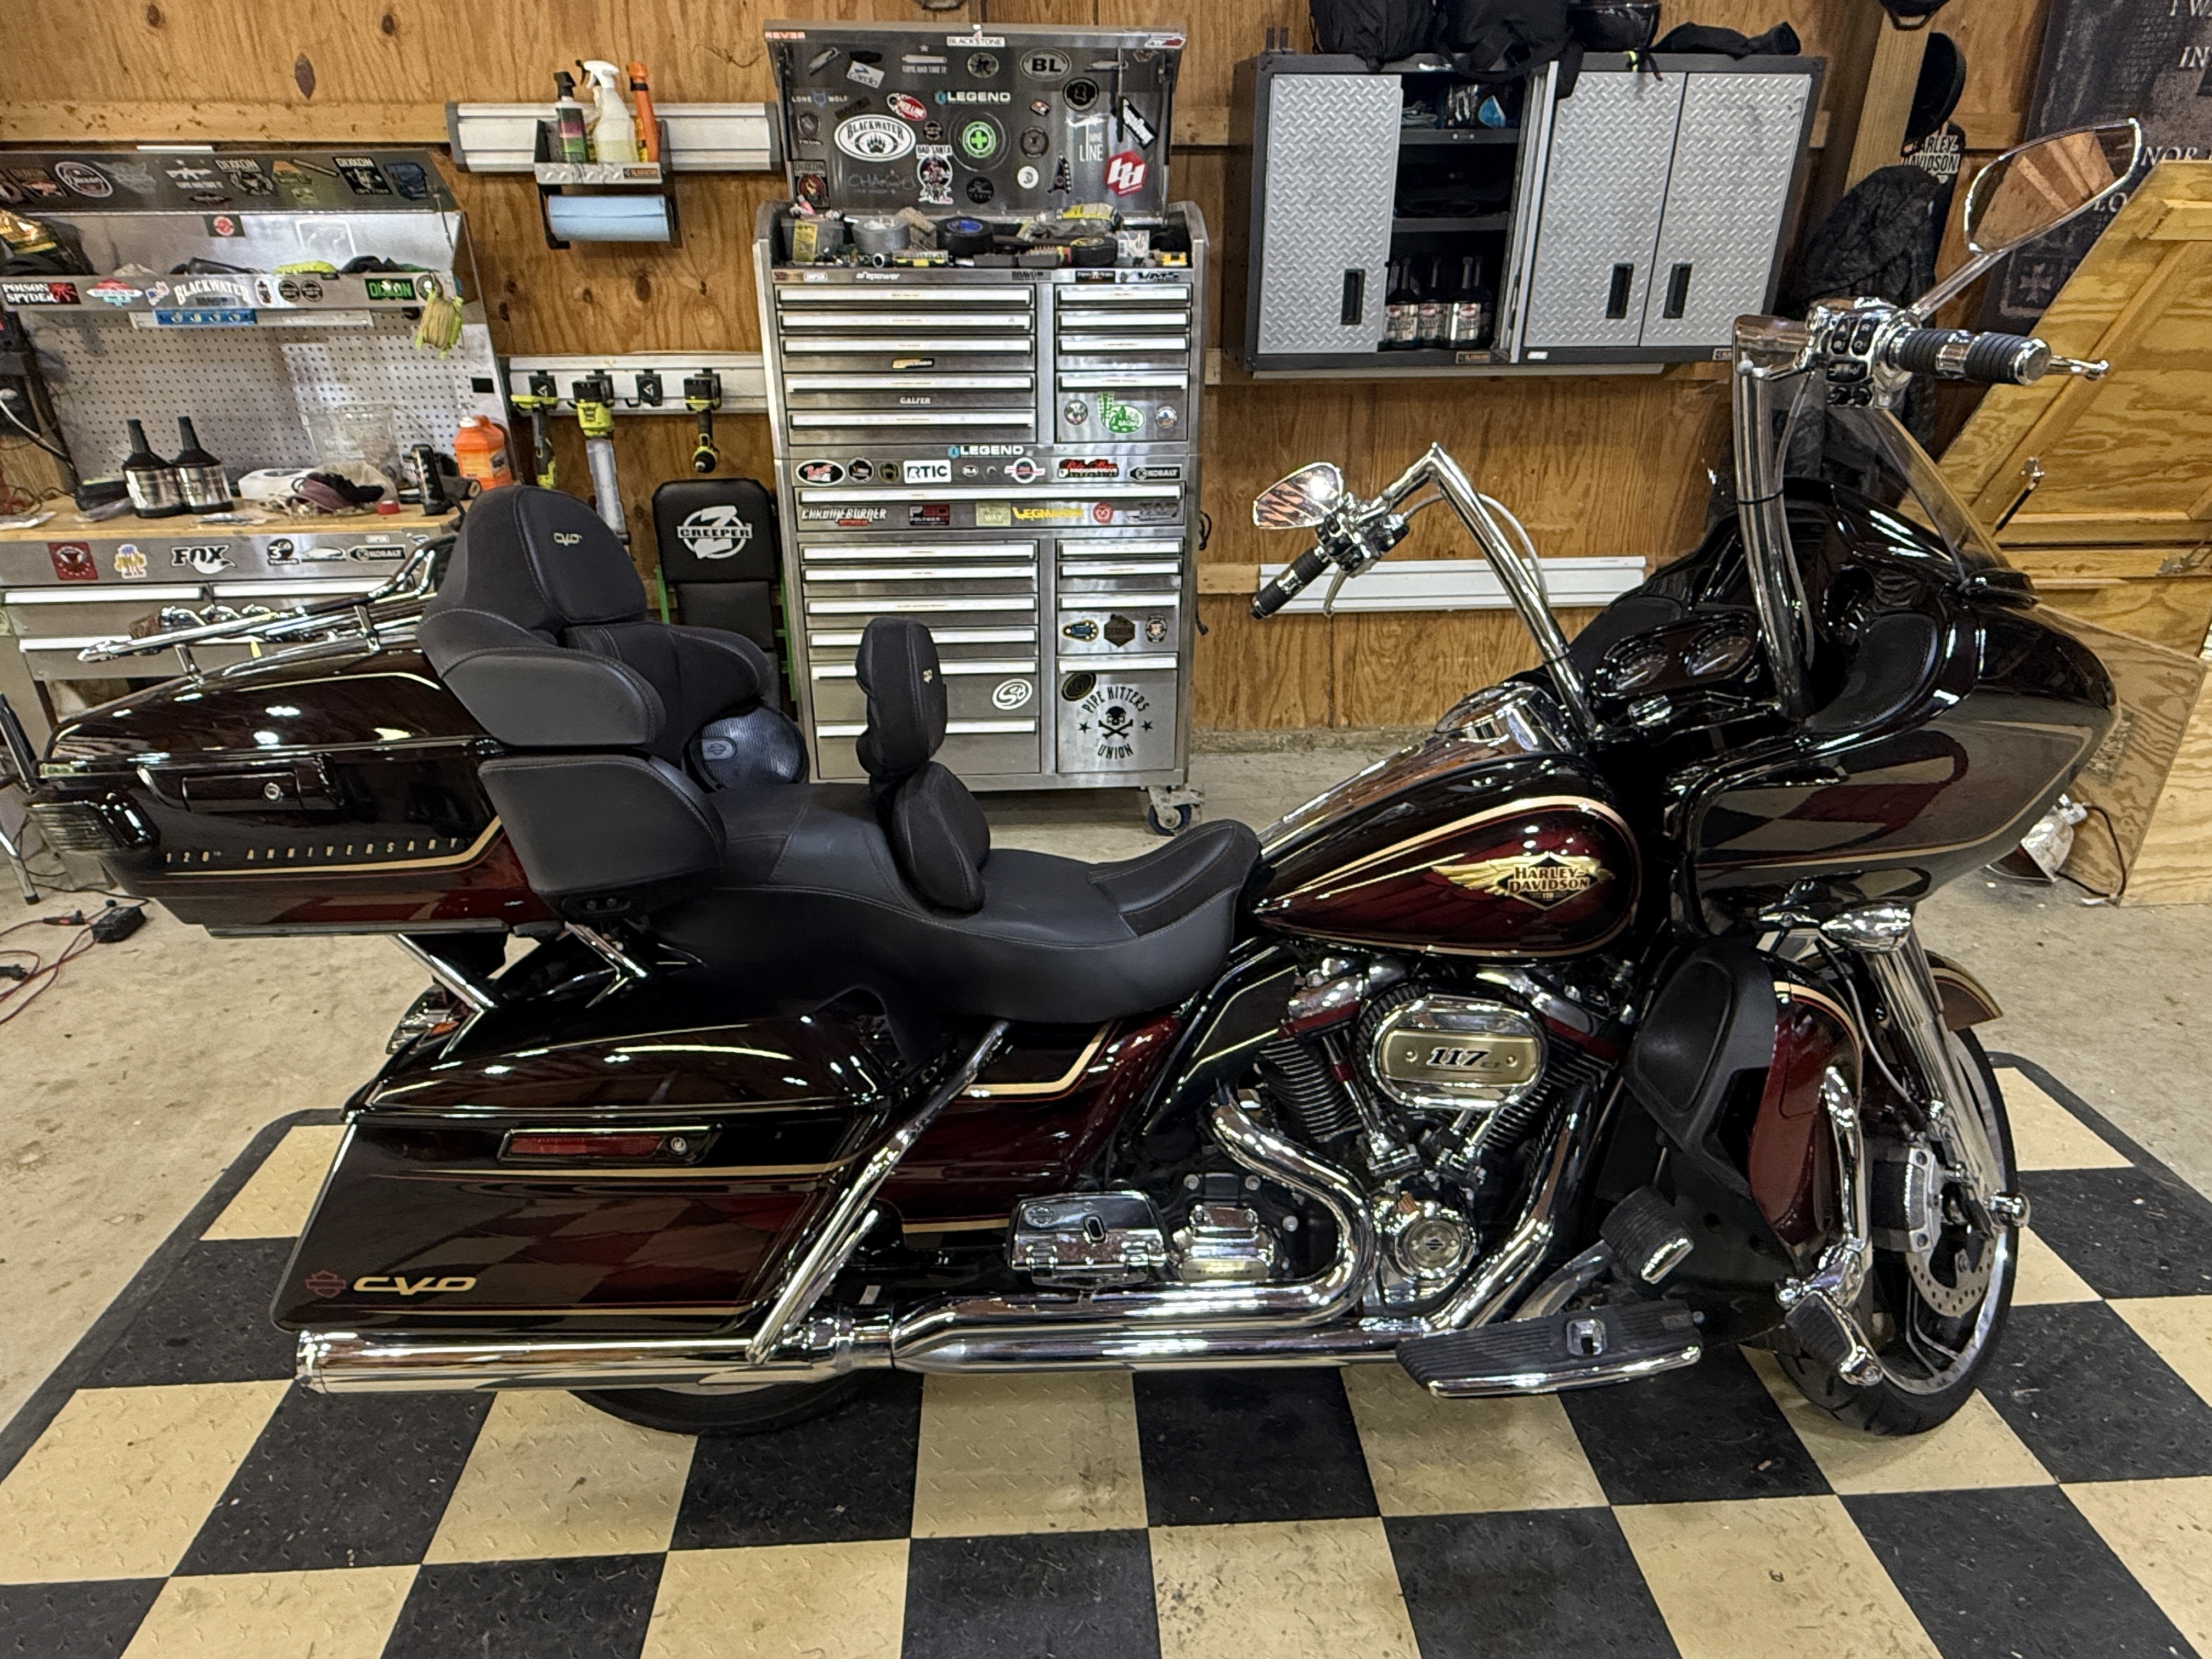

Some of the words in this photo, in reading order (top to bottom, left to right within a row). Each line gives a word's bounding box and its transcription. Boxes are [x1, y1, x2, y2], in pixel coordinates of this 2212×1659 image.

[2178, 46, 2212, 68] IN
[1031, 58, 1062, 72] BL
[947, 91, 1011, 103] LEGEND
[846, 120, 905, 140] BLACKWATER
[917, 145, 929, 154] BAD
[1, 283, 49, 294] POISON
[173, 279, 252, 306] BLACKWATER
[6, 293, 58, 304] SPYDER
[900, 397, 931, 405] GALFER
[960, 445, 1024, 455] LEGEND
[907, 465, 948, 479] RTIC
[679, 528, 751, 538] CREEPER
[173, 546, 227, 564] FOX
[1081, 690, 1105, 713] PIPE
[1107, 686, 1150, 712] HITTERS
[1097, 743, 1134, 759] UNION
[246, 837, 458, 859] ANNIVERSARY
[1514, 866, 1585, 879] HARLEY-
[1509, 879, 1588, 894] DAVIDSON
[1426, 1047, 1492, 1066] 117
[353, 1276, 477, 1296] CVO
